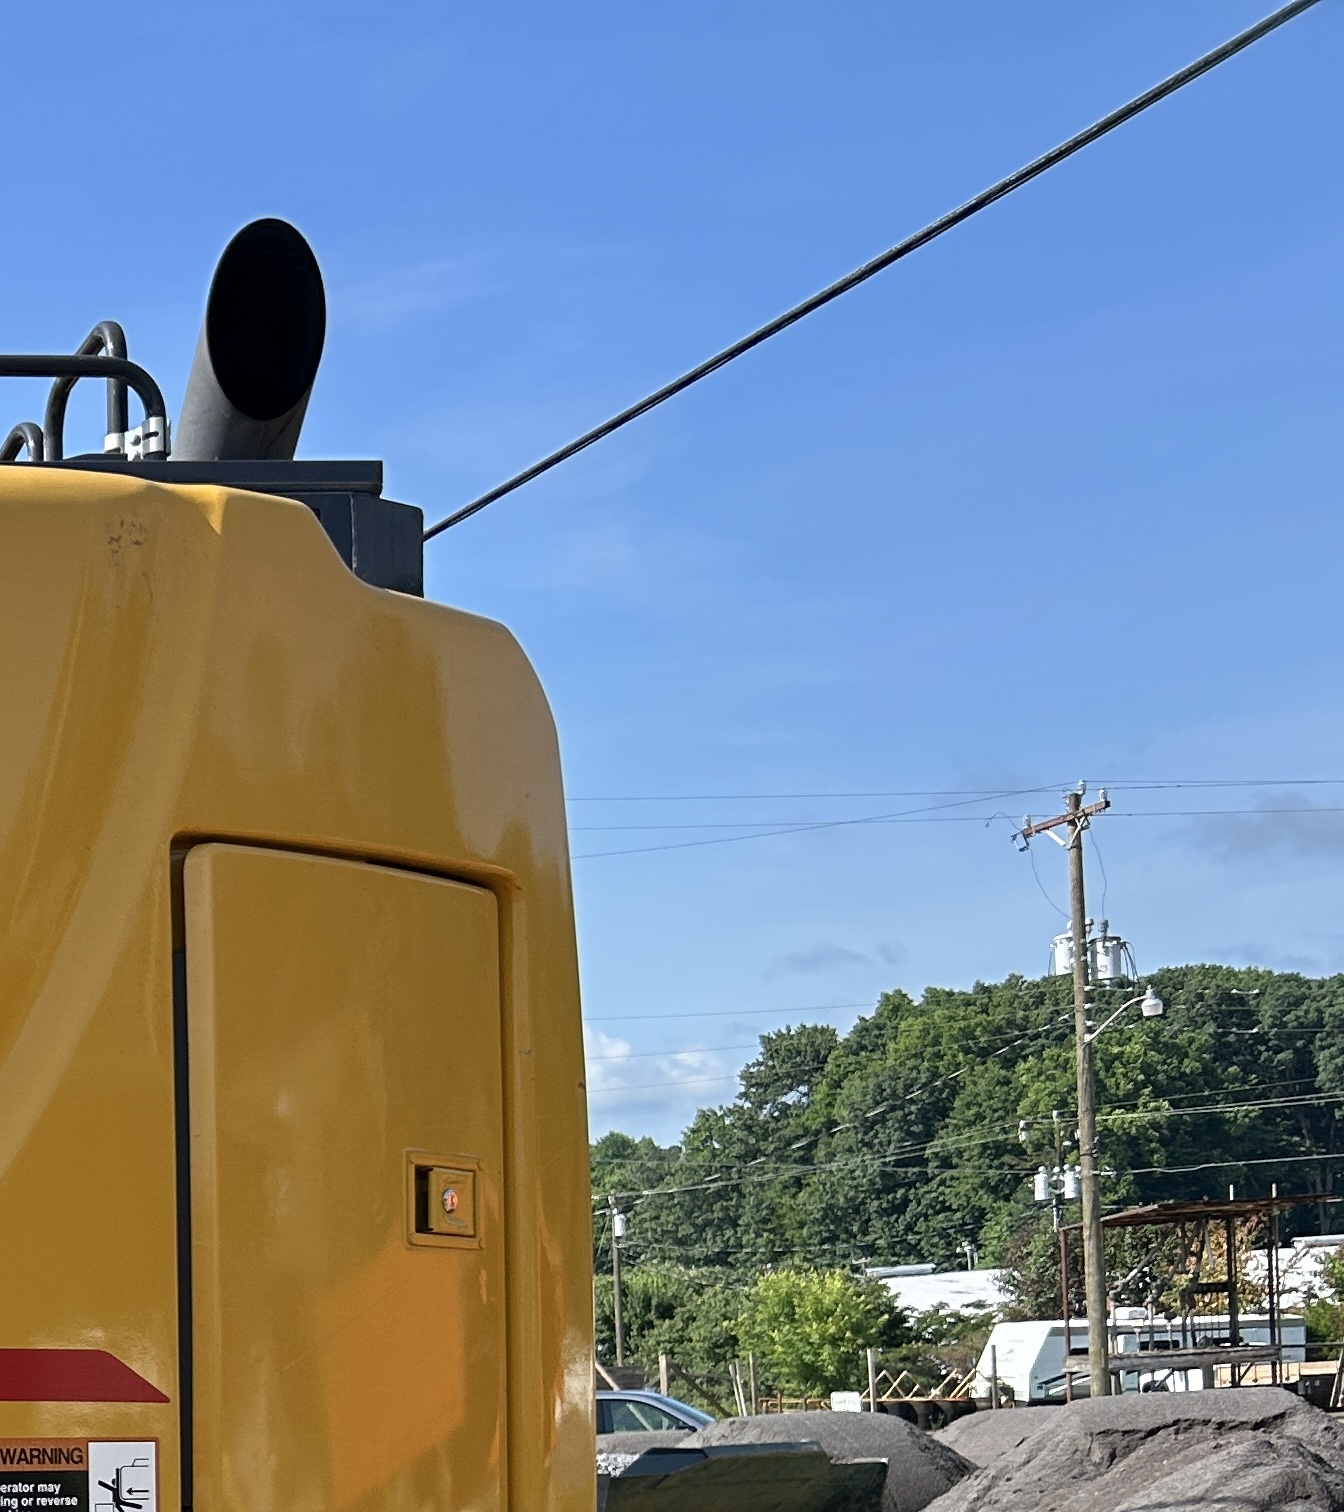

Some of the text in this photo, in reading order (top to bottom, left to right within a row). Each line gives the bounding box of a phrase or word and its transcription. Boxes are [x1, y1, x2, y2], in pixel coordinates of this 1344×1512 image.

[0, 1447, 83, 1465] WARNING
[38, 1483, 61, 1495] may
[21, 1497, 34, 1506] or
[36, 1496, 78, 1506] reverse
